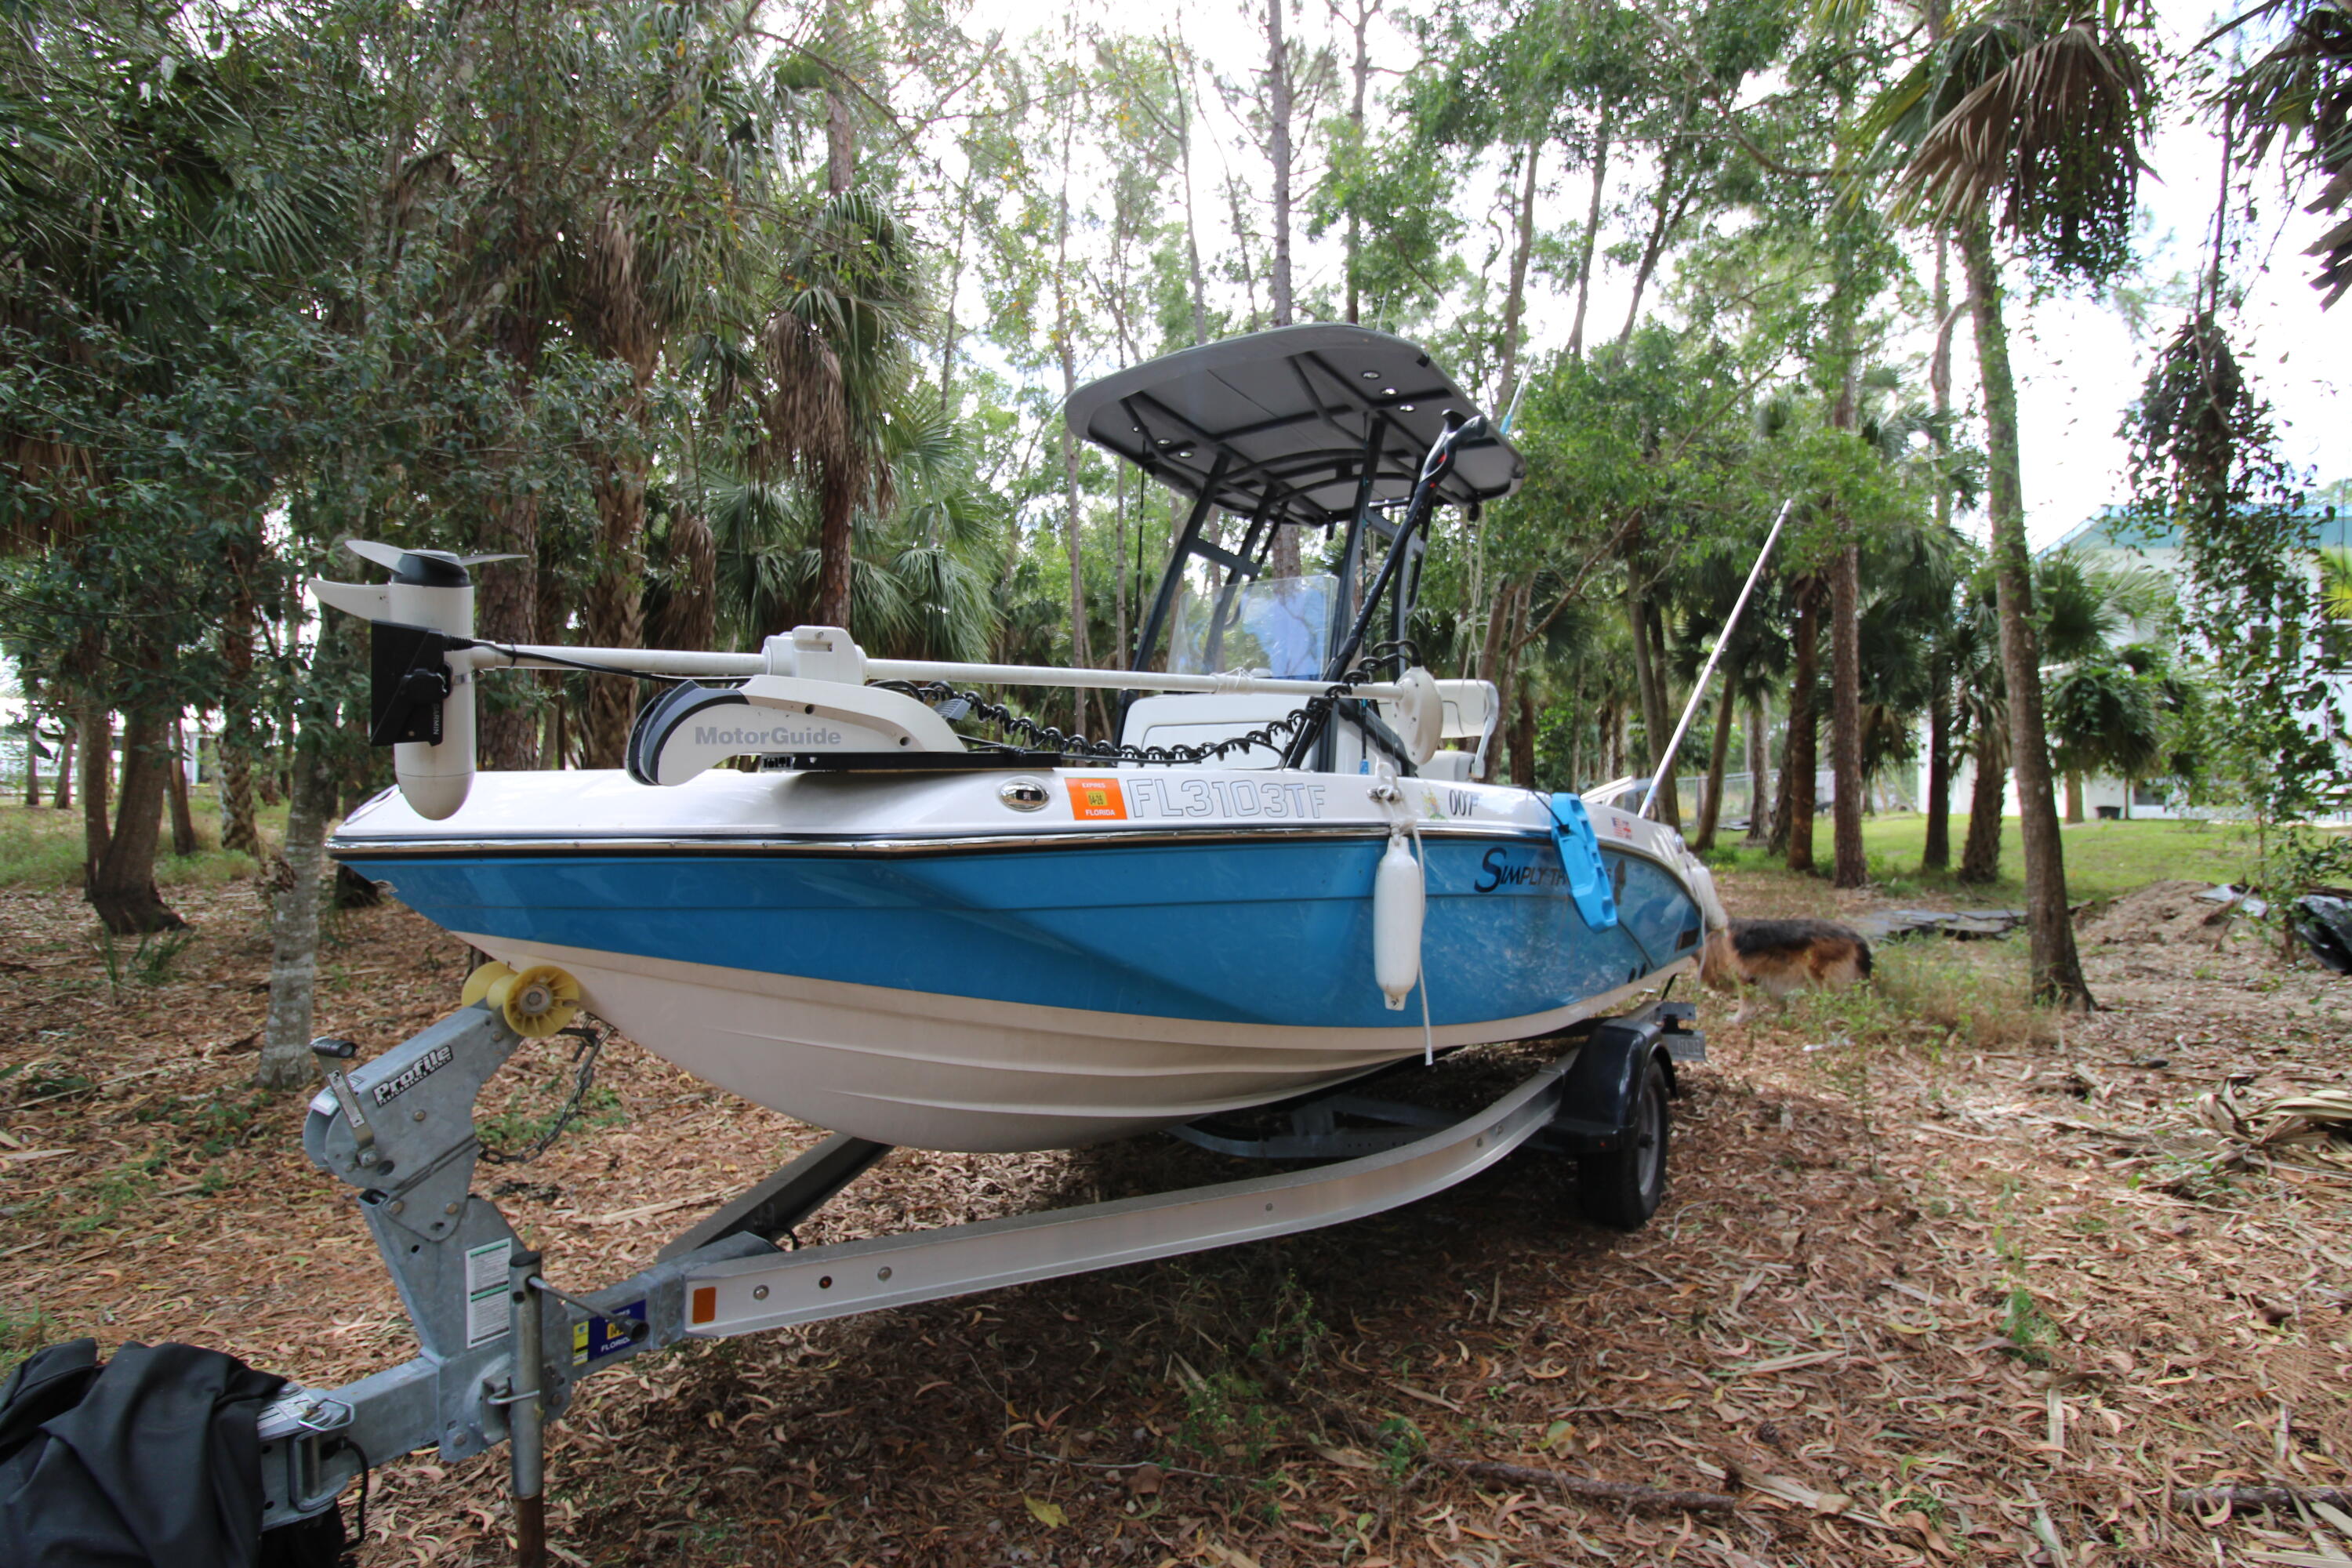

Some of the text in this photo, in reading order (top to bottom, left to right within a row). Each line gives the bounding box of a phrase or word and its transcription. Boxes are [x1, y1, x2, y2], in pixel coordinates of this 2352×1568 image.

[695, 727, 841, 745] MotorGuide
[1127, 778, 1326, 819] FL3103TF
[1474, 848, 1548, 893] SIMPLY
[374, 1046, 450, 1102] Profile
[601, 1337, 630, 1352] FLORID
